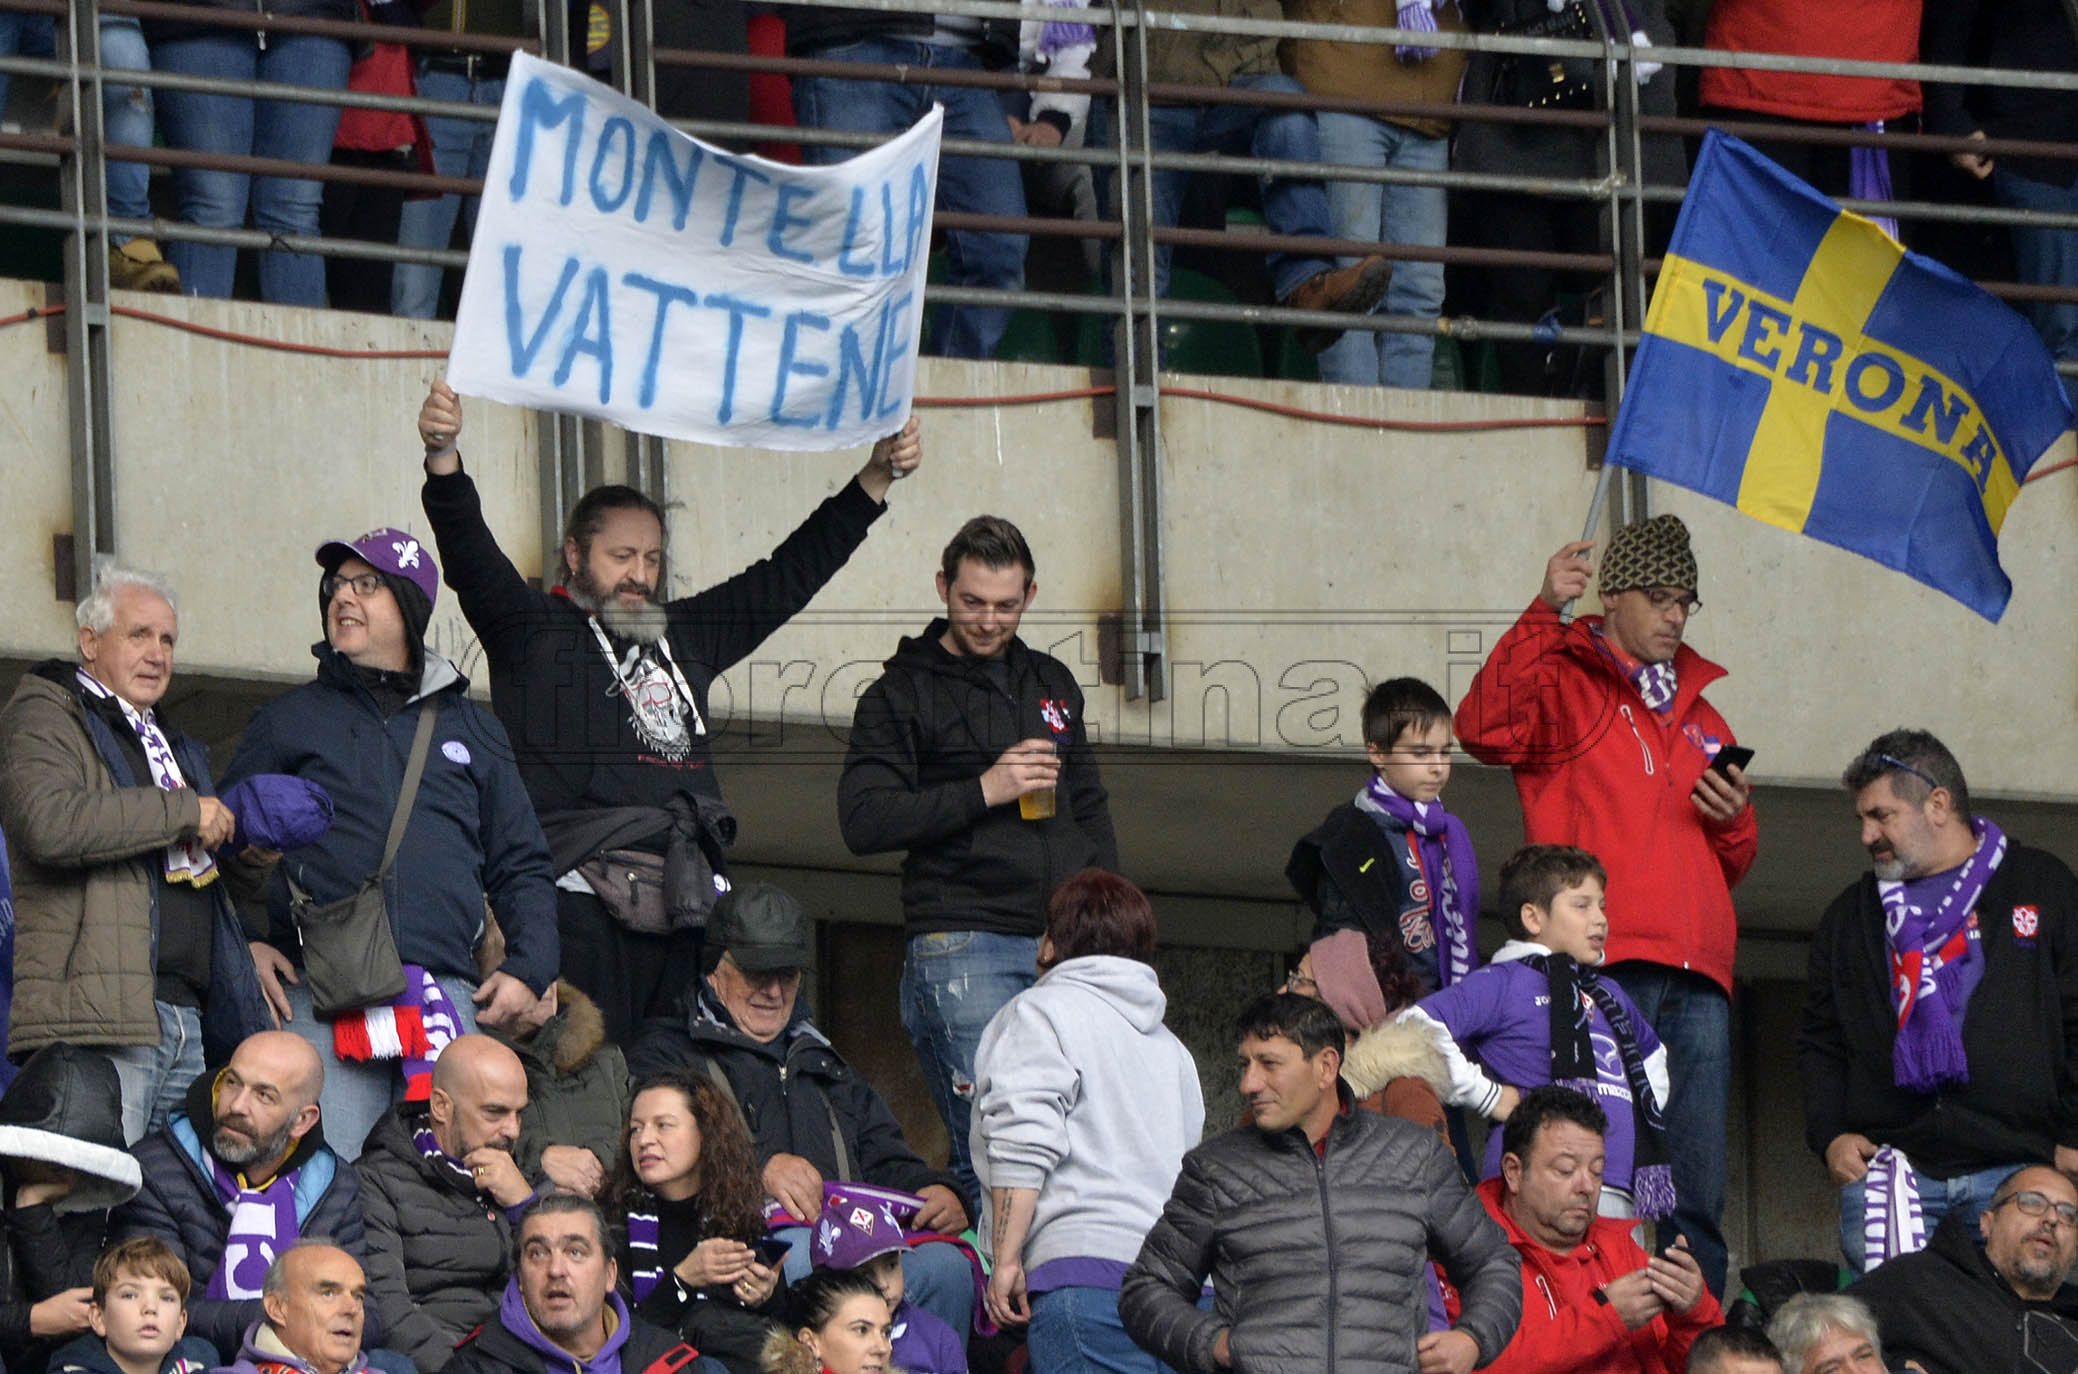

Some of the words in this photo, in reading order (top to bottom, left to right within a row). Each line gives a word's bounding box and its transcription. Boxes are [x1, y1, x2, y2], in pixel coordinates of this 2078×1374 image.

[508, 76, 929, 277] MONTELLA
[501, 245, 914, 431] VATTENE
[1701, 278, 1999, 493] VERONA
